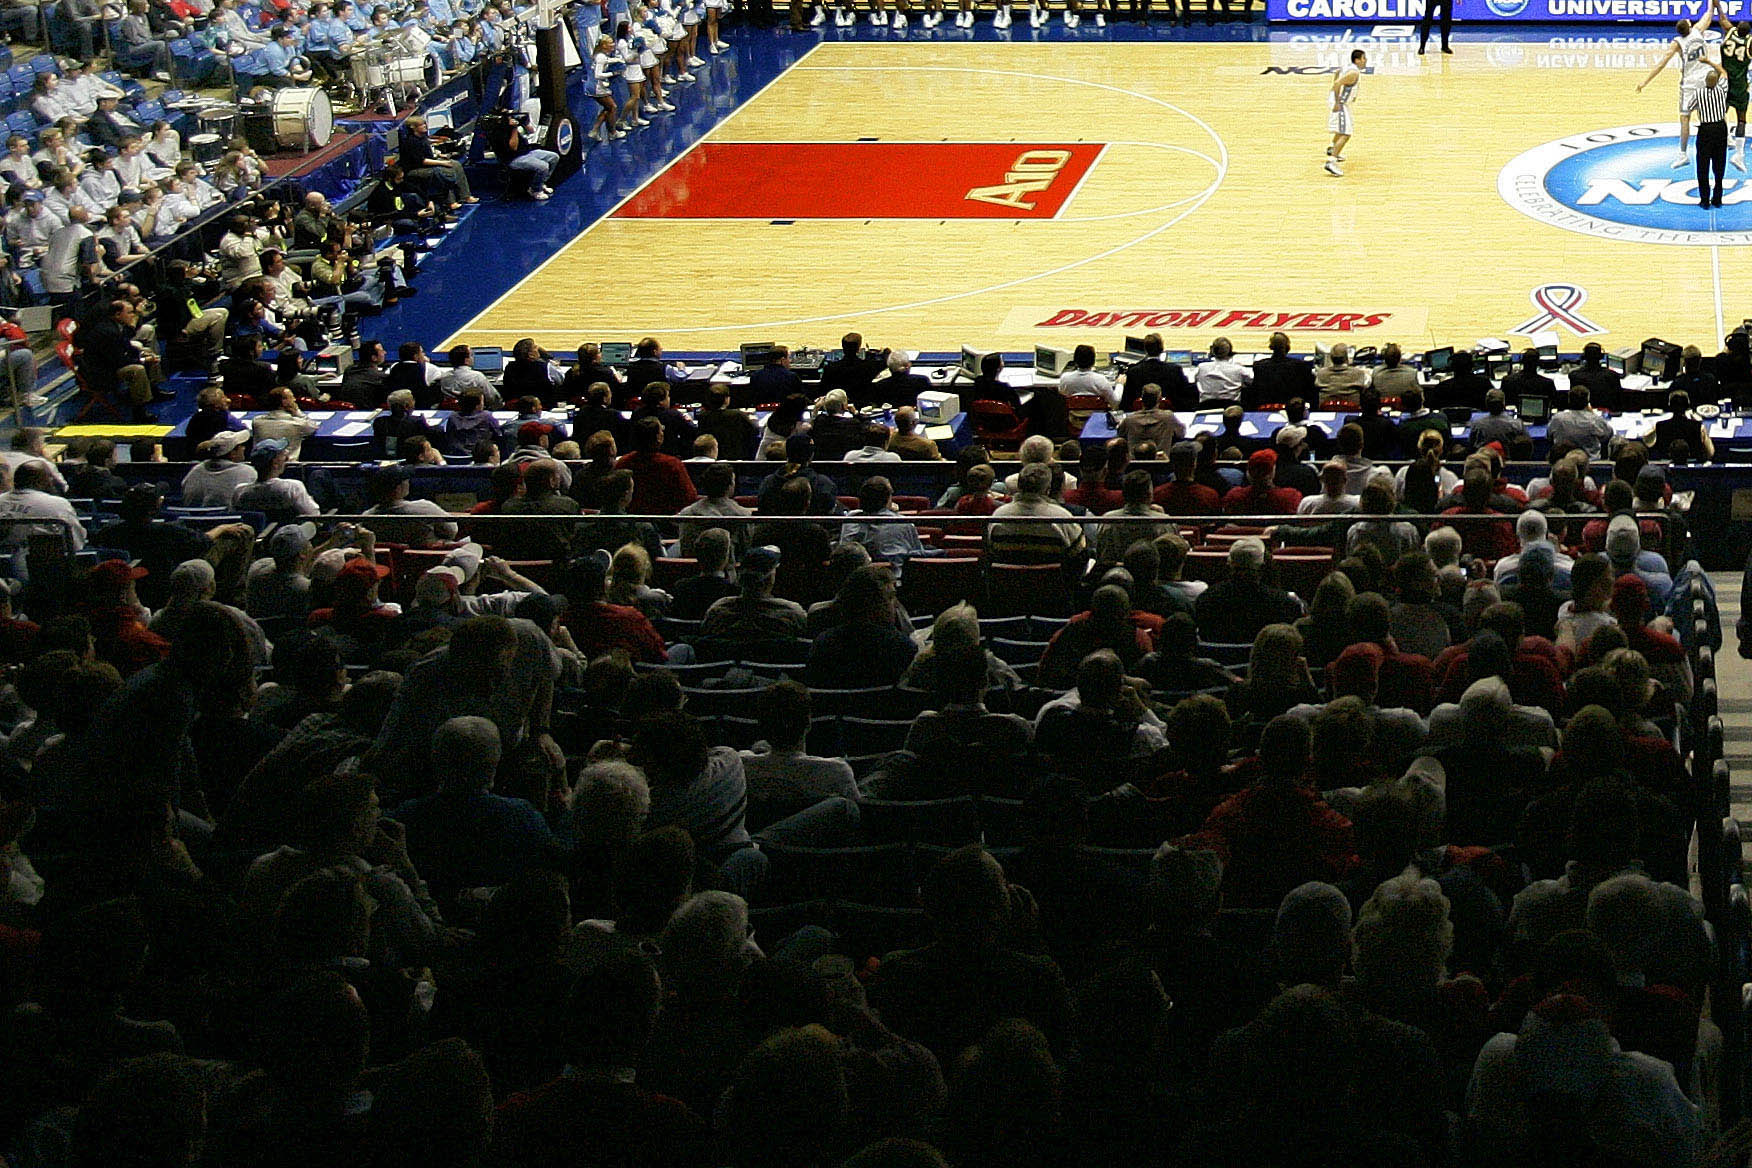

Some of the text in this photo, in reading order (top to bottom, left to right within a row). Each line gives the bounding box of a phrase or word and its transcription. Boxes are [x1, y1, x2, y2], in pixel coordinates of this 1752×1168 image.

[1548, 0, 1702, 15] UNIVERSITY
[1723, 40, 1747, 62] 34
[965, 148, 1074, 211] A10
[1516, 174, 1626, 236] CELEBRATING
[1034, 308, 1391, 332] DAYTON FLYERS
